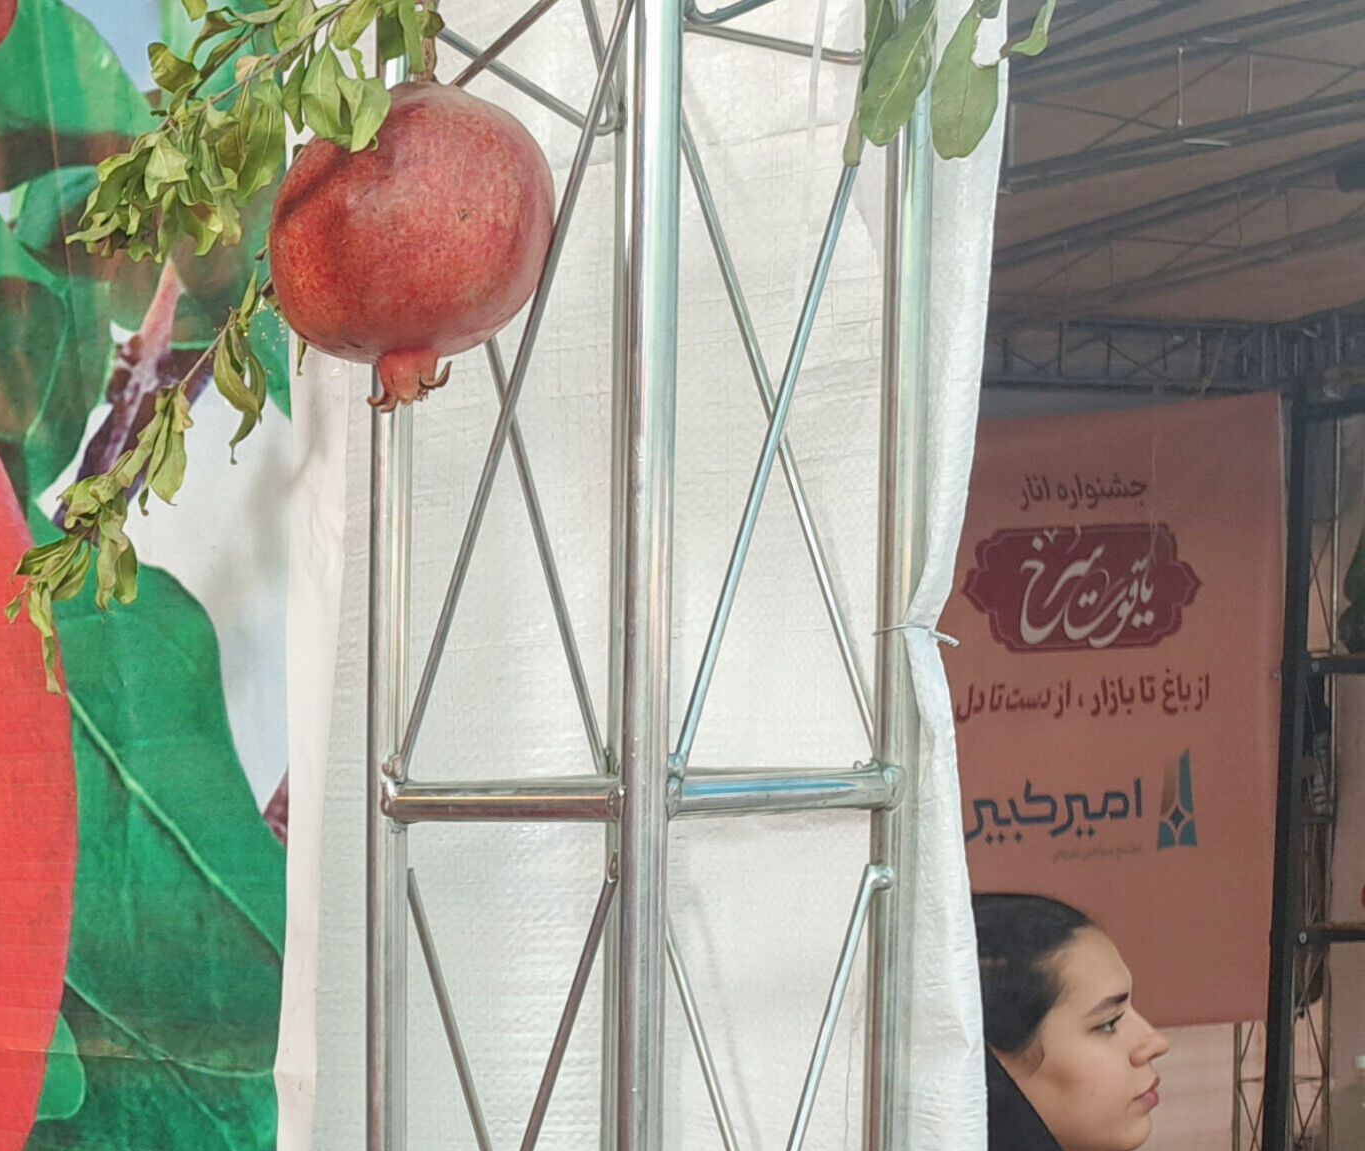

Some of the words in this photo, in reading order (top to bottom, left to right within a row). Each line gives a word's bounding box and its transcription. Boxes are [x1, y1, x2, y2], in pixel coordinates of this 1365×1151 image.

[1020, 473, 1051, 512] انار
[1057, 472, 1148, 509] جشنواره
[1063, 556, 1155, 648] یاقوت
[955, 682, 985, 724] دل
[989, 683, 1005, 713] تا
[1005, 686, 1051, 712] دست
[1053, 679, 1071, 719] از
[1139, 674, 1156, 703] تا
[1161, 668, 1191, 715] باغ
[1194, 673, 1210, 712] از
